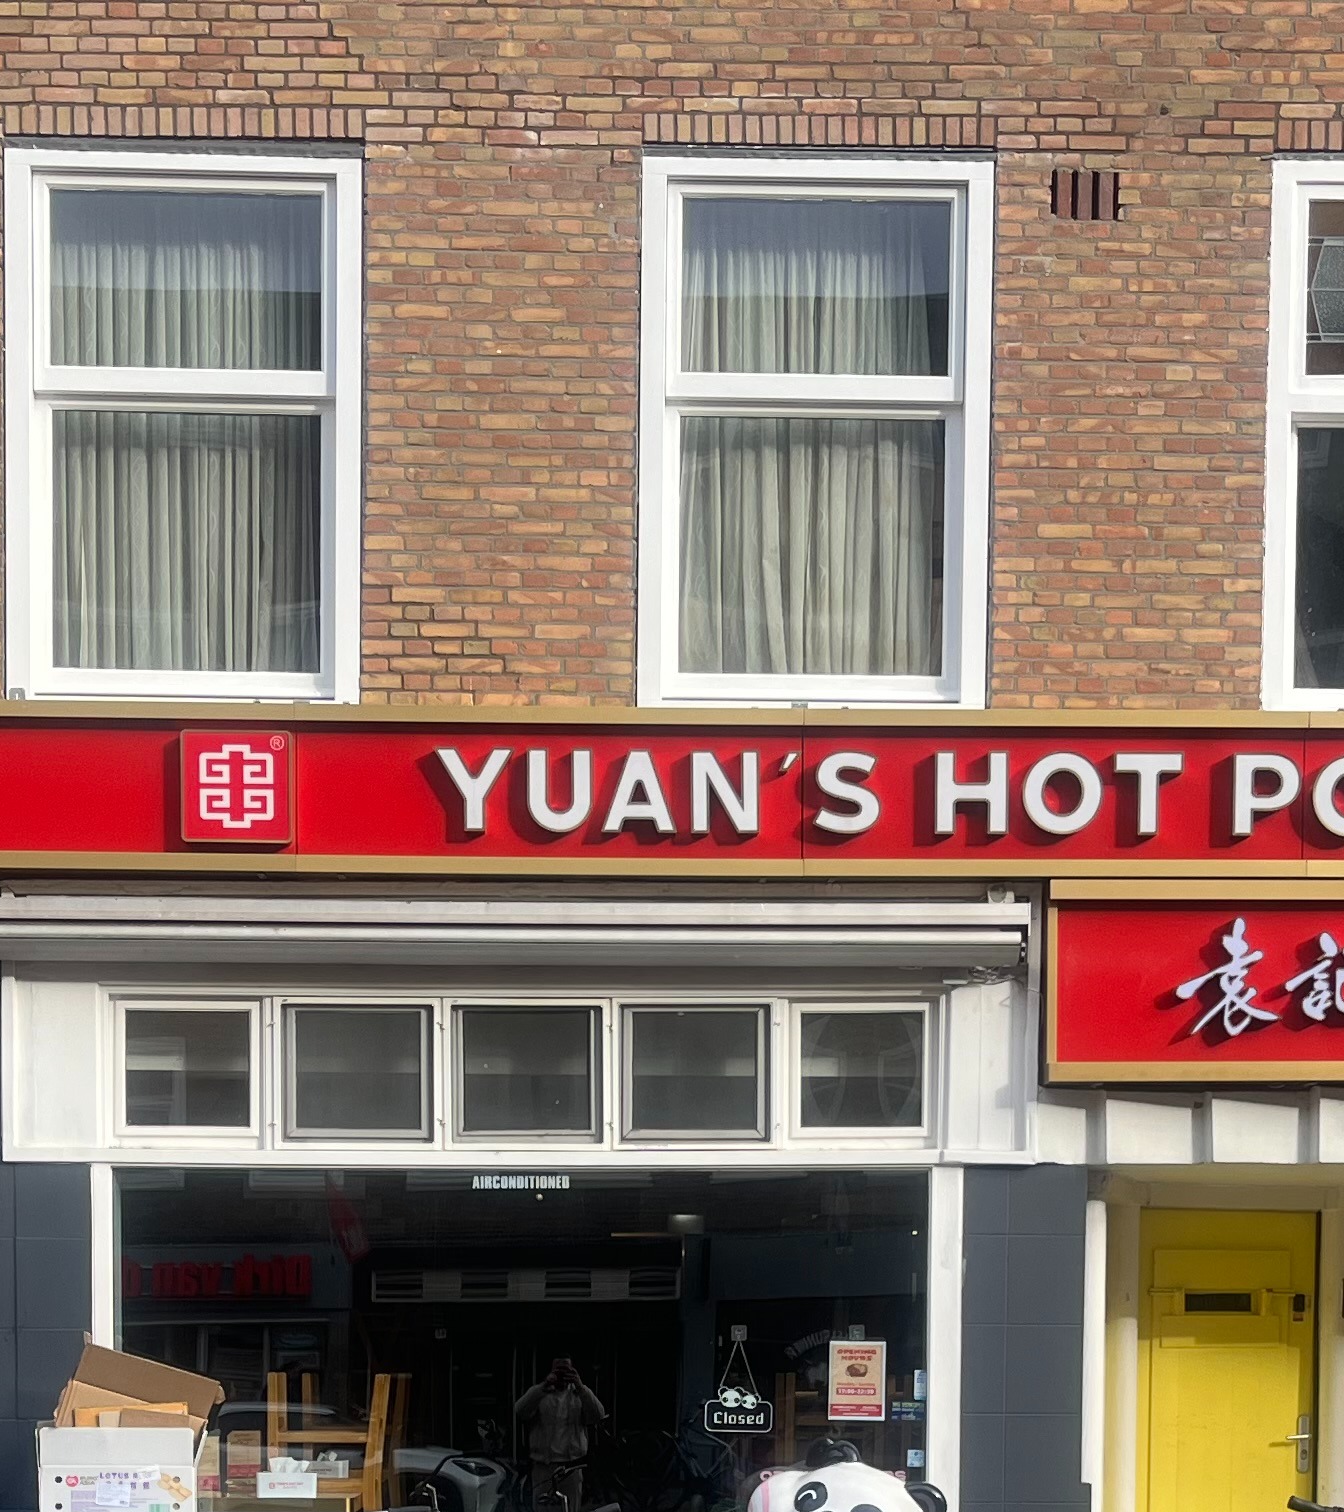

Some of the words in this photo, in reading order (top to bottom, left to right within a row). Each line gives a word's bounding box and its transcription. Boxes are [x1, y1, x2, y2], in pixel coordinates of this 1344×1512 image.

[435, 748, 880, 834] YUAN'S
[935, 751, 1184, 836] HOT
[472, 1175, 570, 1189] AIRCONDITIONED
[713, 1411, 764, 1425] Closed
[99, 1472, 129, 1480] LOTUS
